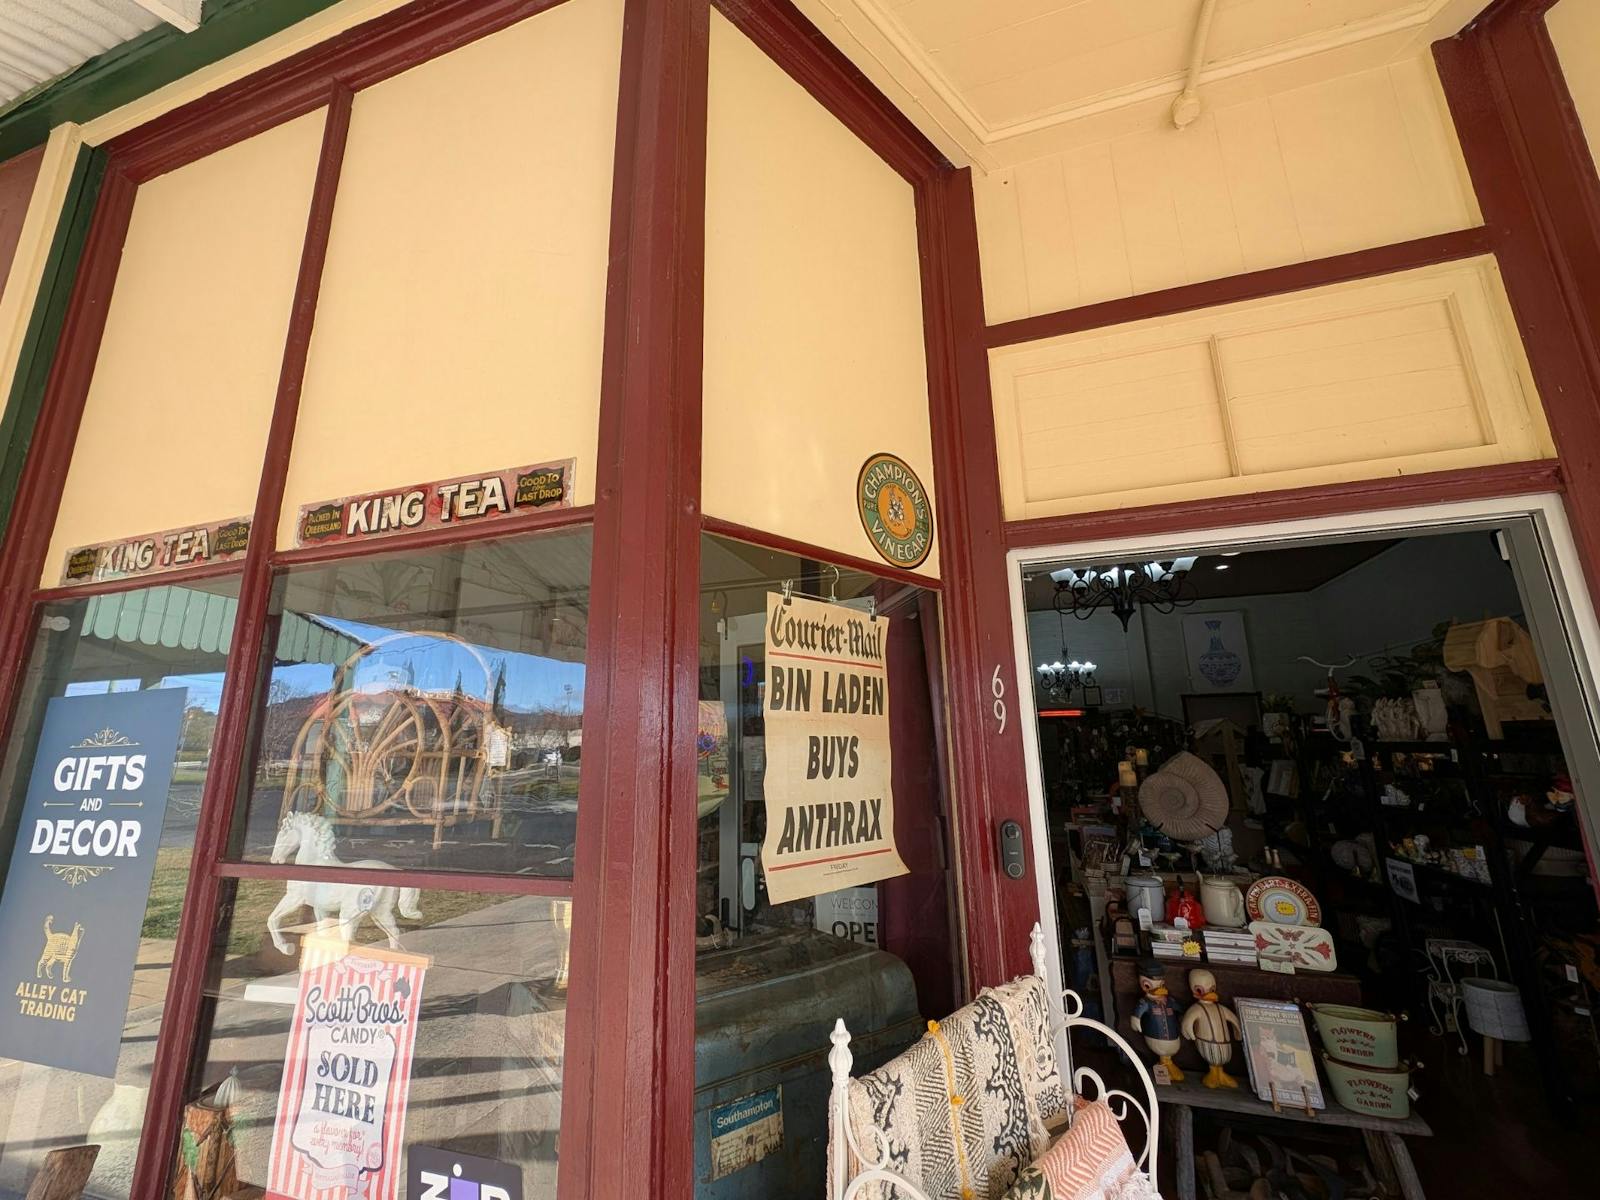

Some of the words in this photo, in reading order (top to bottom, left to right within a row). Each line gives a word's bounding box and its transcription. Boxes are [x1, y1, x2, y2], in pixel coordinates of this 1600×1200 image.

[516, 490, 538, 503] LAST
[539, 488, 562, 499] DROP
[519, 475, 546, 487] GOOD
[546, 473, 560, 483] TO
[865, 464, 926, 519] CHAMPION'S
[346, 491, 425, 535] KING
[438, 476, 508, 522] TEA
[100, 540, 154, 573] KING
[163, 529, 211, 566] TEA
[872, 520, 926, 560] VINEGAR
[770, 604, 882, 660] Courier-Mail
[770, 665, 812, 712] BIN
[822, 671, 884, 716] LADEN
[53, 755, 147, 791] GIFTS
[806, 735, 859, 780] BUYS
[80, 798, 103, 811] AND
[29, 819, 142, 857] DECOR
[776, 798, 882, 855] ANTHRAX
[832, 920, 878, 943] OPE
[16, 982, 57, 1000] ALLEY
[60, 988, 87, 1005] CAT
[20, 999, 76, 1022] TRADING
[305, 986, 354, 1023] Scott
[353, 985, 408, 1025] Bros.
[1331, 1026, 1376, 1041] FLOWERS
[1340, 1046, 1374, 1057] GARDEN
[317, 1050, 378, 1088] SOLD
[1345, 1079, 1393, 1095] FLOWERS
[311, 1082, 376, 1125] HERE
[716, 1099, 774, 1129] Southampton
[1357, 1097, 1392, 1109] GARDEN
